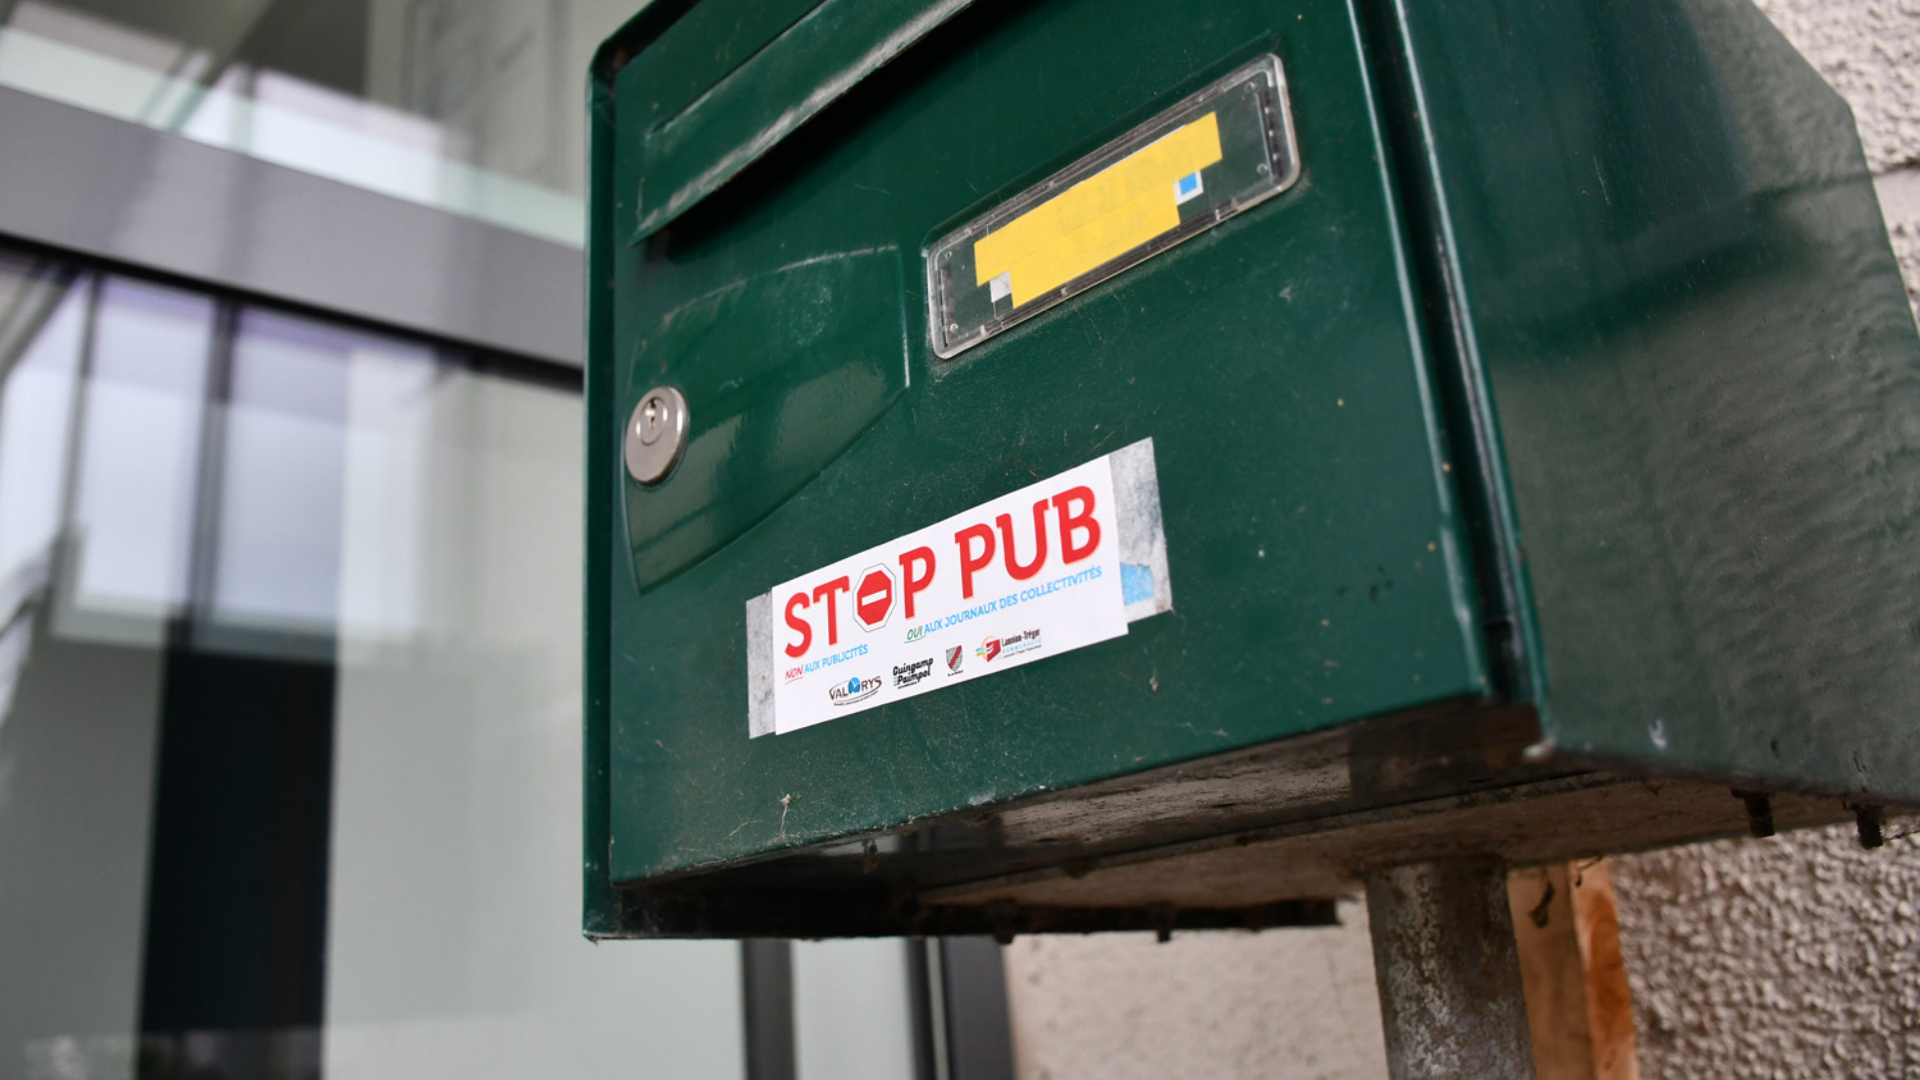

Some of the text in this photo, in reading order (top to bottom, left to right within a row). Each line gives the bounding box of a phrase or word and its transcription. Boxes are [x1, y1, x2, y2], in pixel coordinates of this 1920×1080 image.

[784, 485, 1102, 659] STOP PUB
[906, 565, 1103, 641] OUI AUX JOURNAUX DES COLLECTIVITÉS
[785, 643, 869, 680] NON AUX PUBLICITÉS
[892, 657, 934, 676] Guingamp
[896, 665, 931, 685] Paimpol
